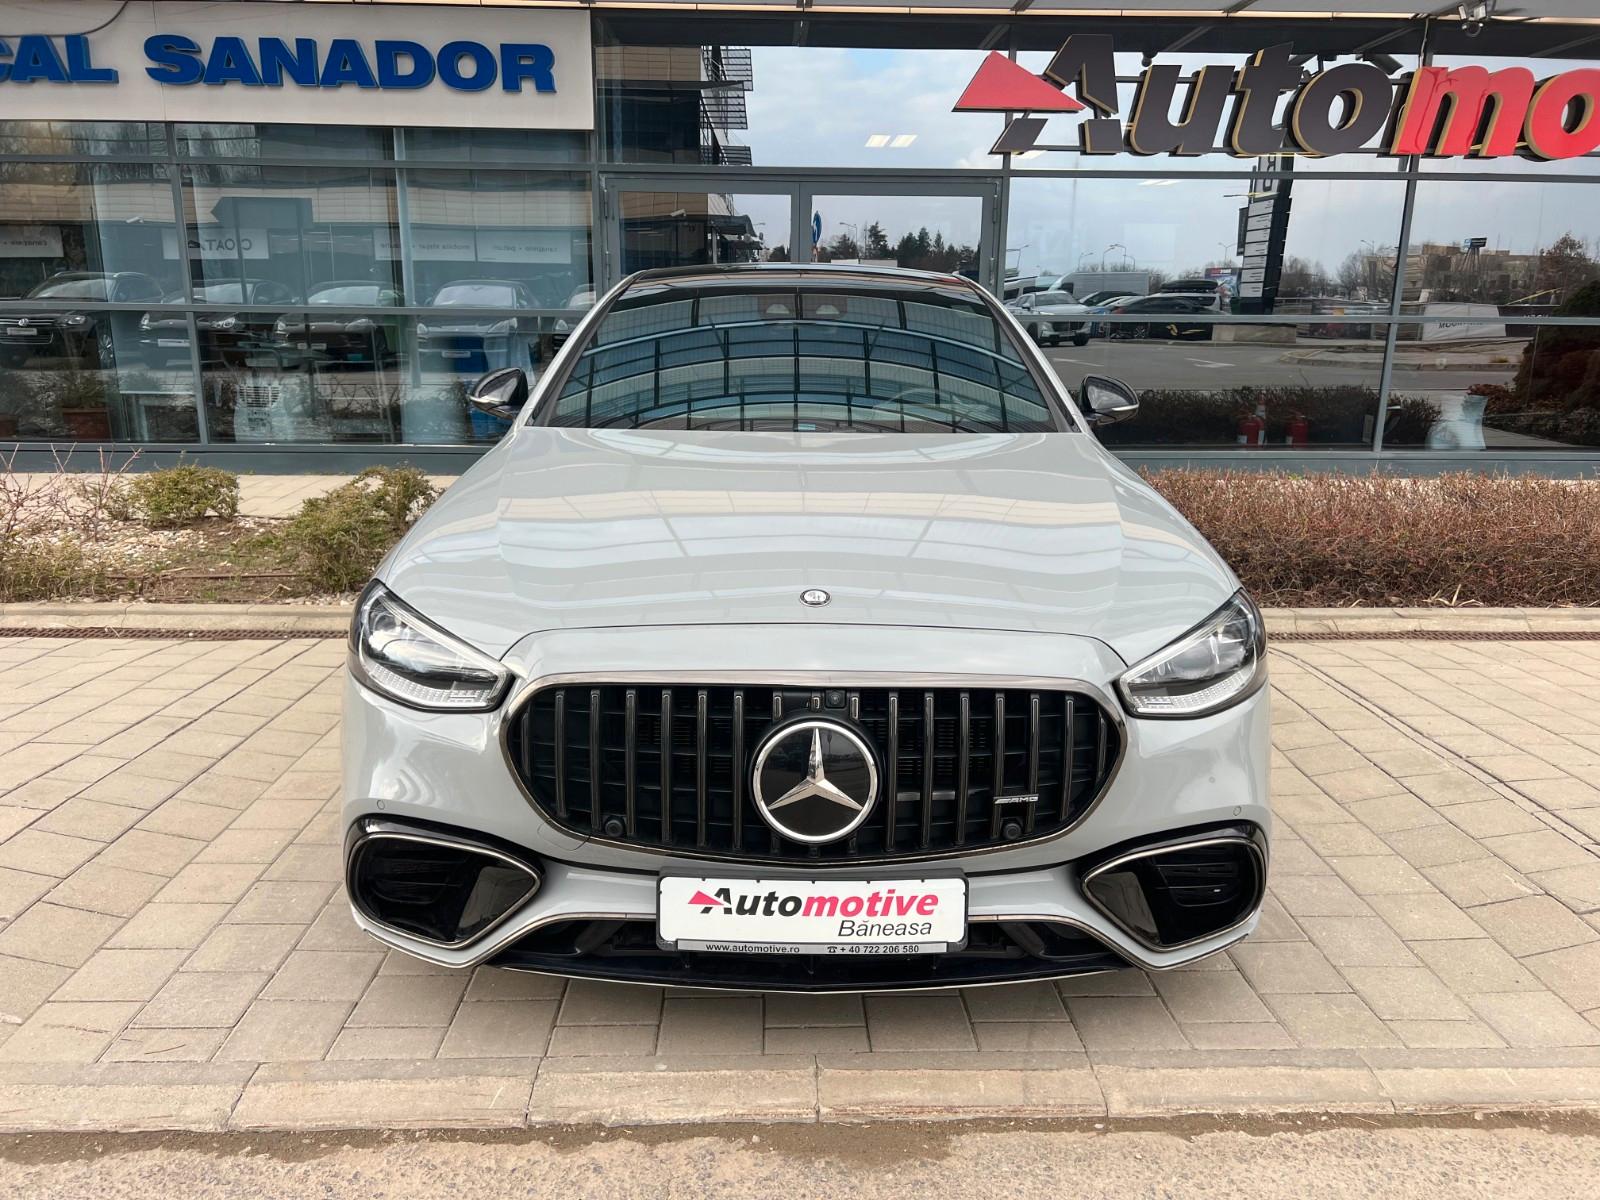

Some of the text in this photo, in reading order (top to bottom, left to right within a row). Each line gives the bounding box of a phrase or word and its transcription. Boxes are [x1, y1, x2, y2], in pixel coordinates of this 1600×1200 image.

[0, 34, 557, 93] AL SANADOR
[699, 888, 939, 917] Automotive
[838, 919, 932, 937] Băneasa
[705, 943, 800, 954] www.automotive.ro
[848, 944, 860, 953] 40
[863, 944, 879, 953] 722
[882, 944, 899, 953] 206
[902, 944, 920, 953] 580
